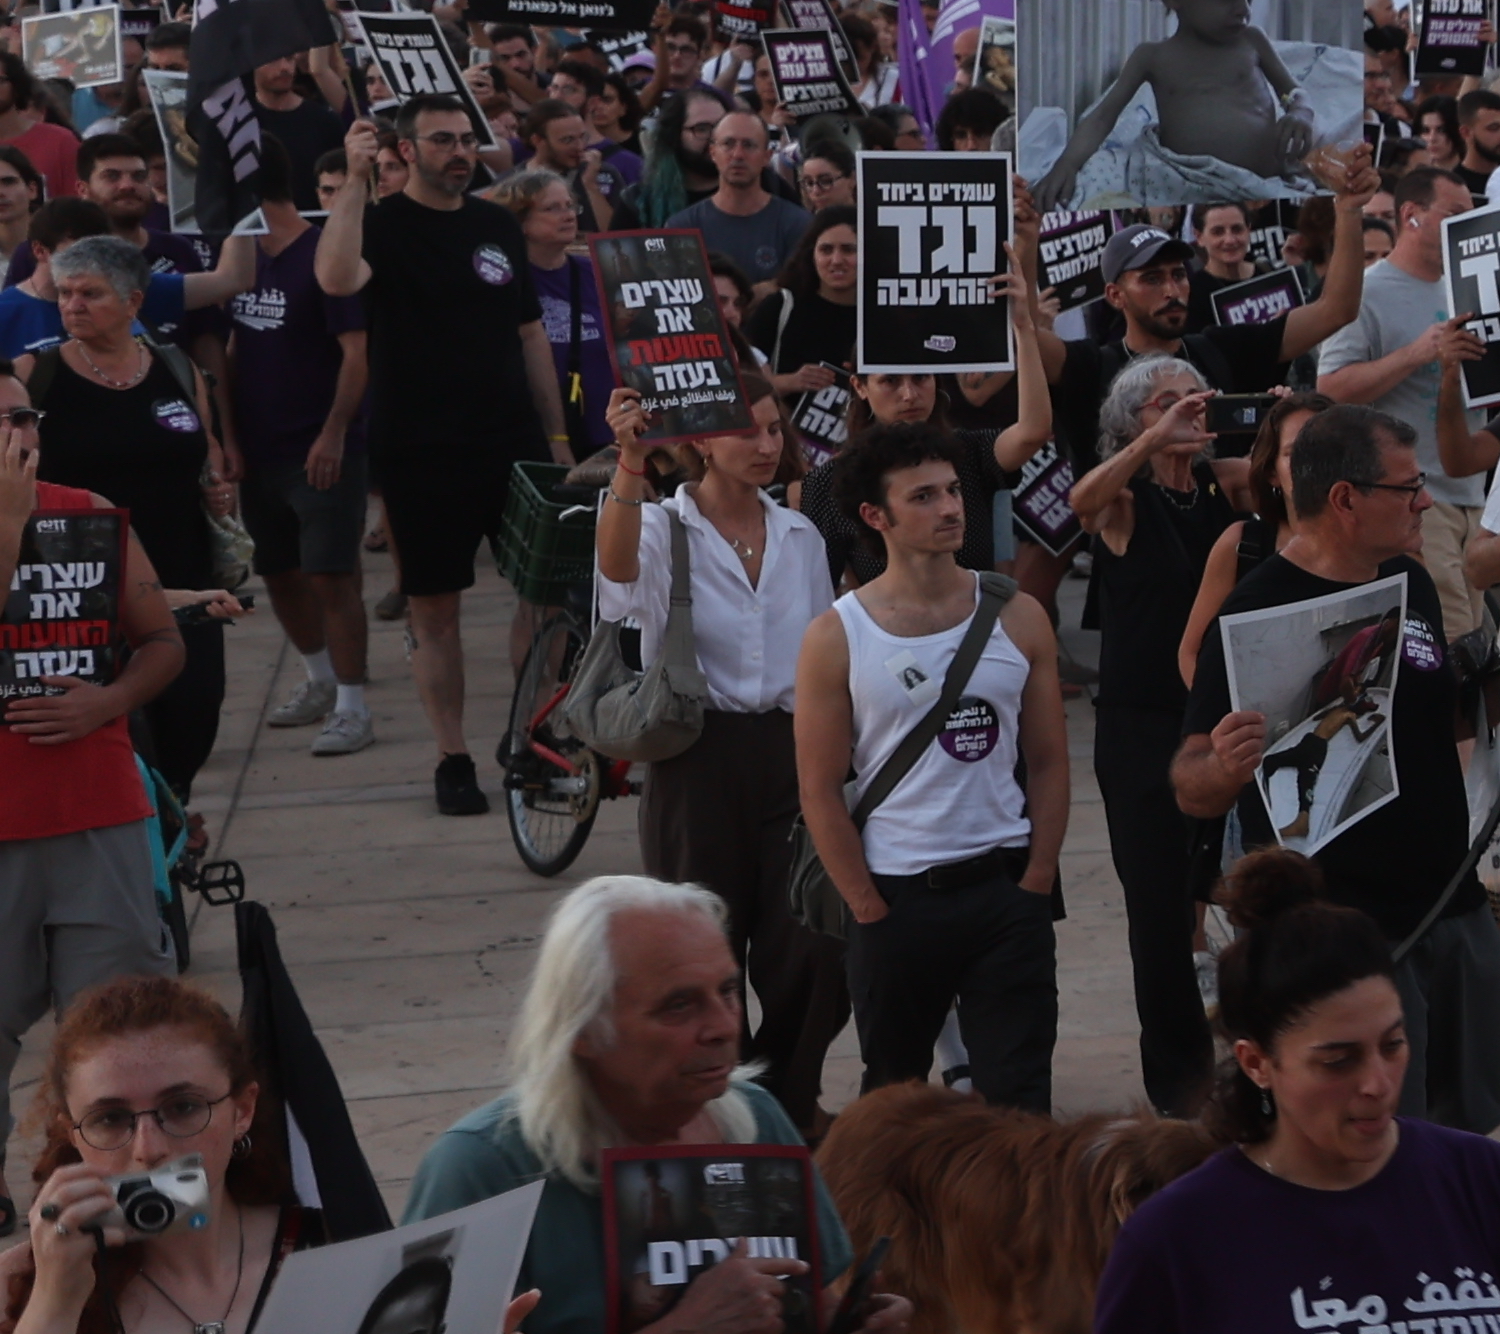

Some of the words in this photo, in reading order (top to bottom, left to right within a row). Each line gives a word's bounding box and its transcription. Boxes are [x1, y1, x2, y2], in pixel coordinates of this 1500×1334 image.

[775, 41, 826, 63] מצילים
[377, 48, 458, 95] נגד
[876, 182, 926, 203] ביחד
[928, 182, 997, 202] עומדים
[876, 205, 997, 275] נגד
[1039, 224, 1107, 263] מסרבים
[1458, 236, 1496, 257] ביחד
[620, 278, 704, 309] עוצרים
[876, 277, 997, 307] ההרעבה
[1226, 286, 1292, 325] מצילים
[654, 306, 695, 334] את
[628, 334, 724, 366] הזוועות
[652, 361, 722, 392] בעזה
[29, 591, 81, 620] את
[14, 649, 96, 679] בעזה
[1290, 1275, 1387, 1331] معًا
